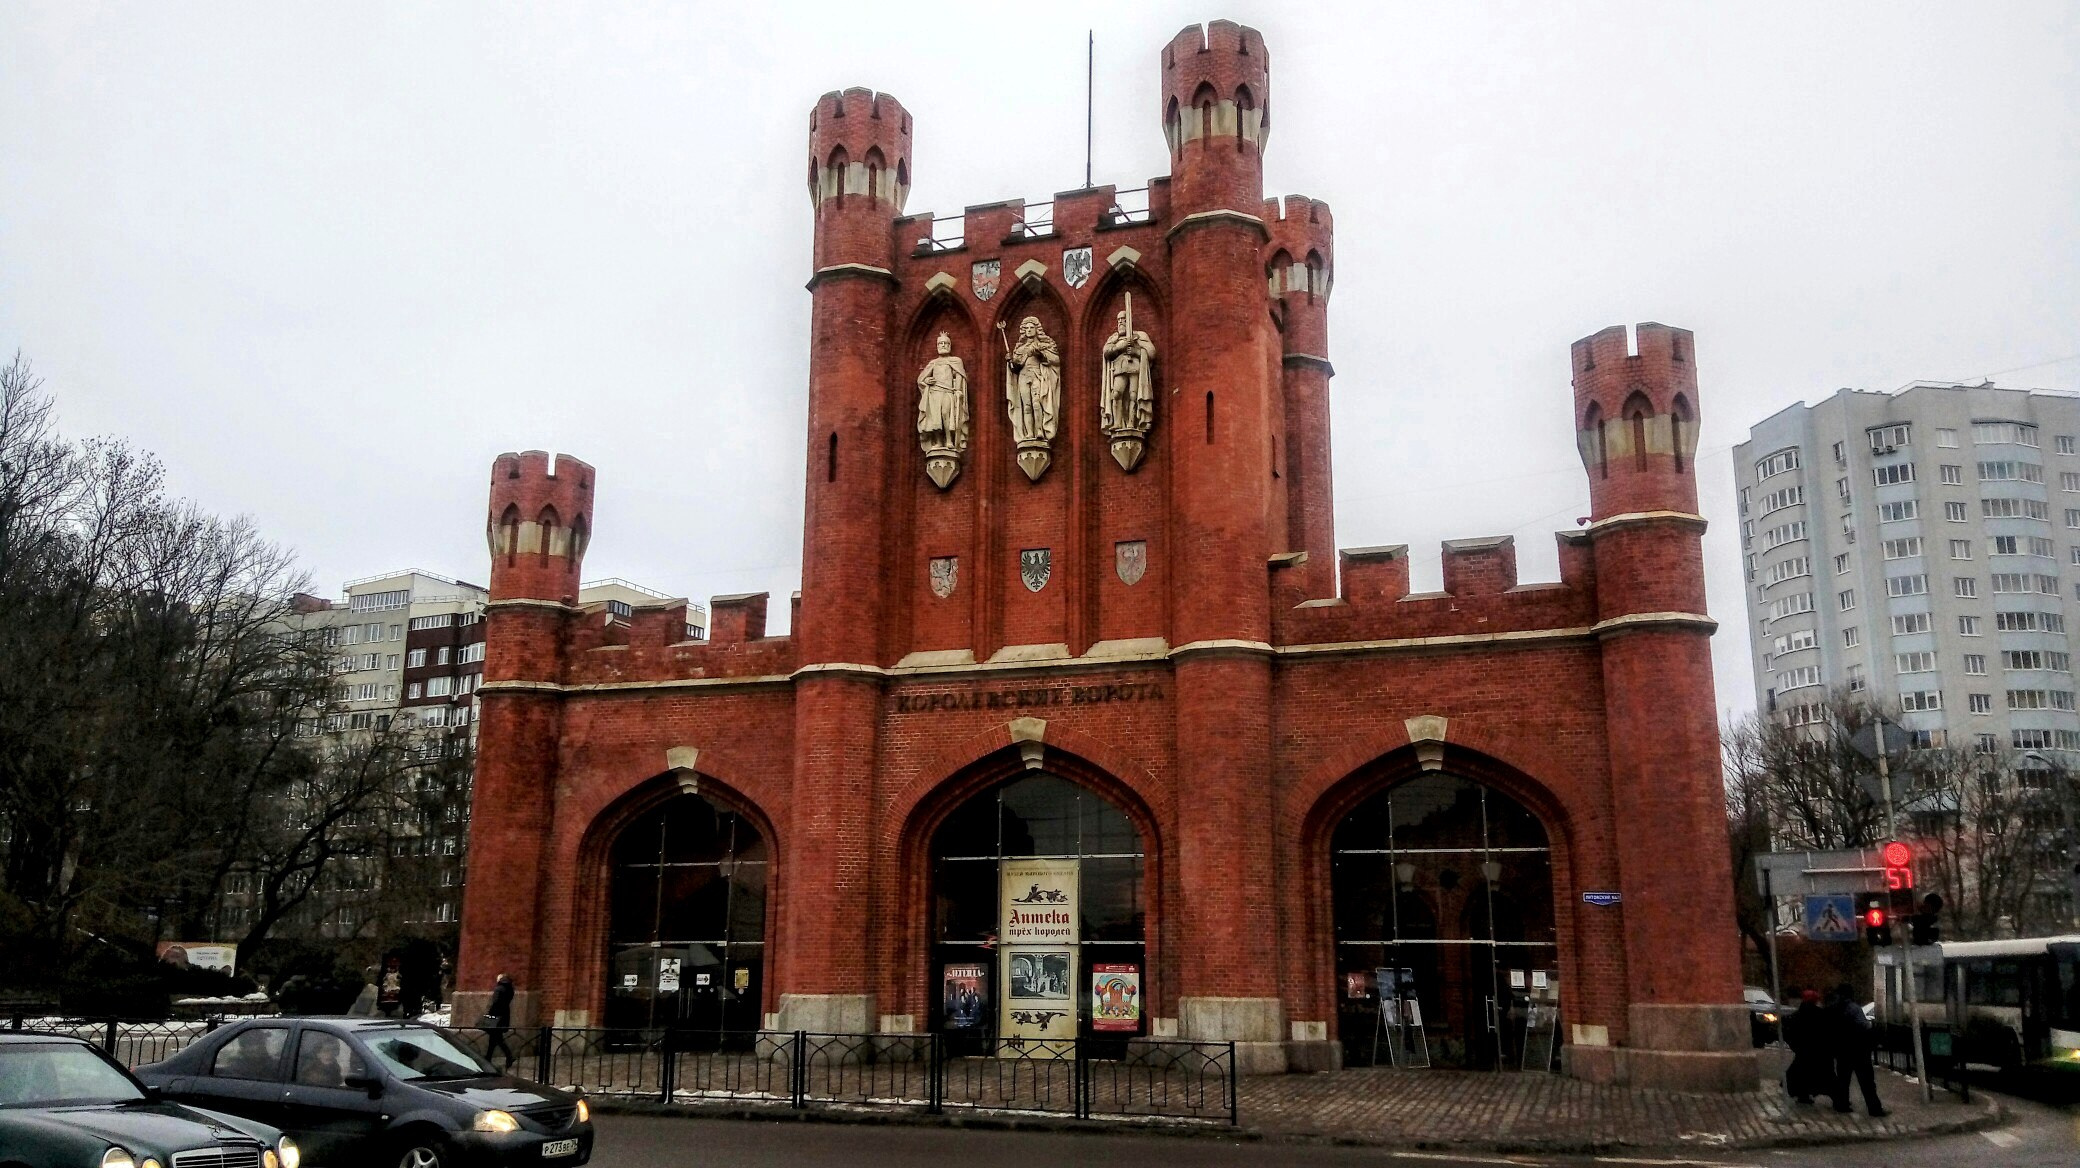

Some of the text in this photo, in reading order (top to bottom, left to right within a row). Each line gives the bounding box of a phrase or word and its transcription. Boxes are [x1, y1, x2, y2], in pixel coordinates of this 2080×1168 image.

[897, 683, 1164, 712] КОРОЛЕВСКИЕ ВОРОТА
[1887, 867, 1912, 889] 57
[1008, 908, 1070, 928] Аптека
[1009, 926, 1071, 938] трёх королей
